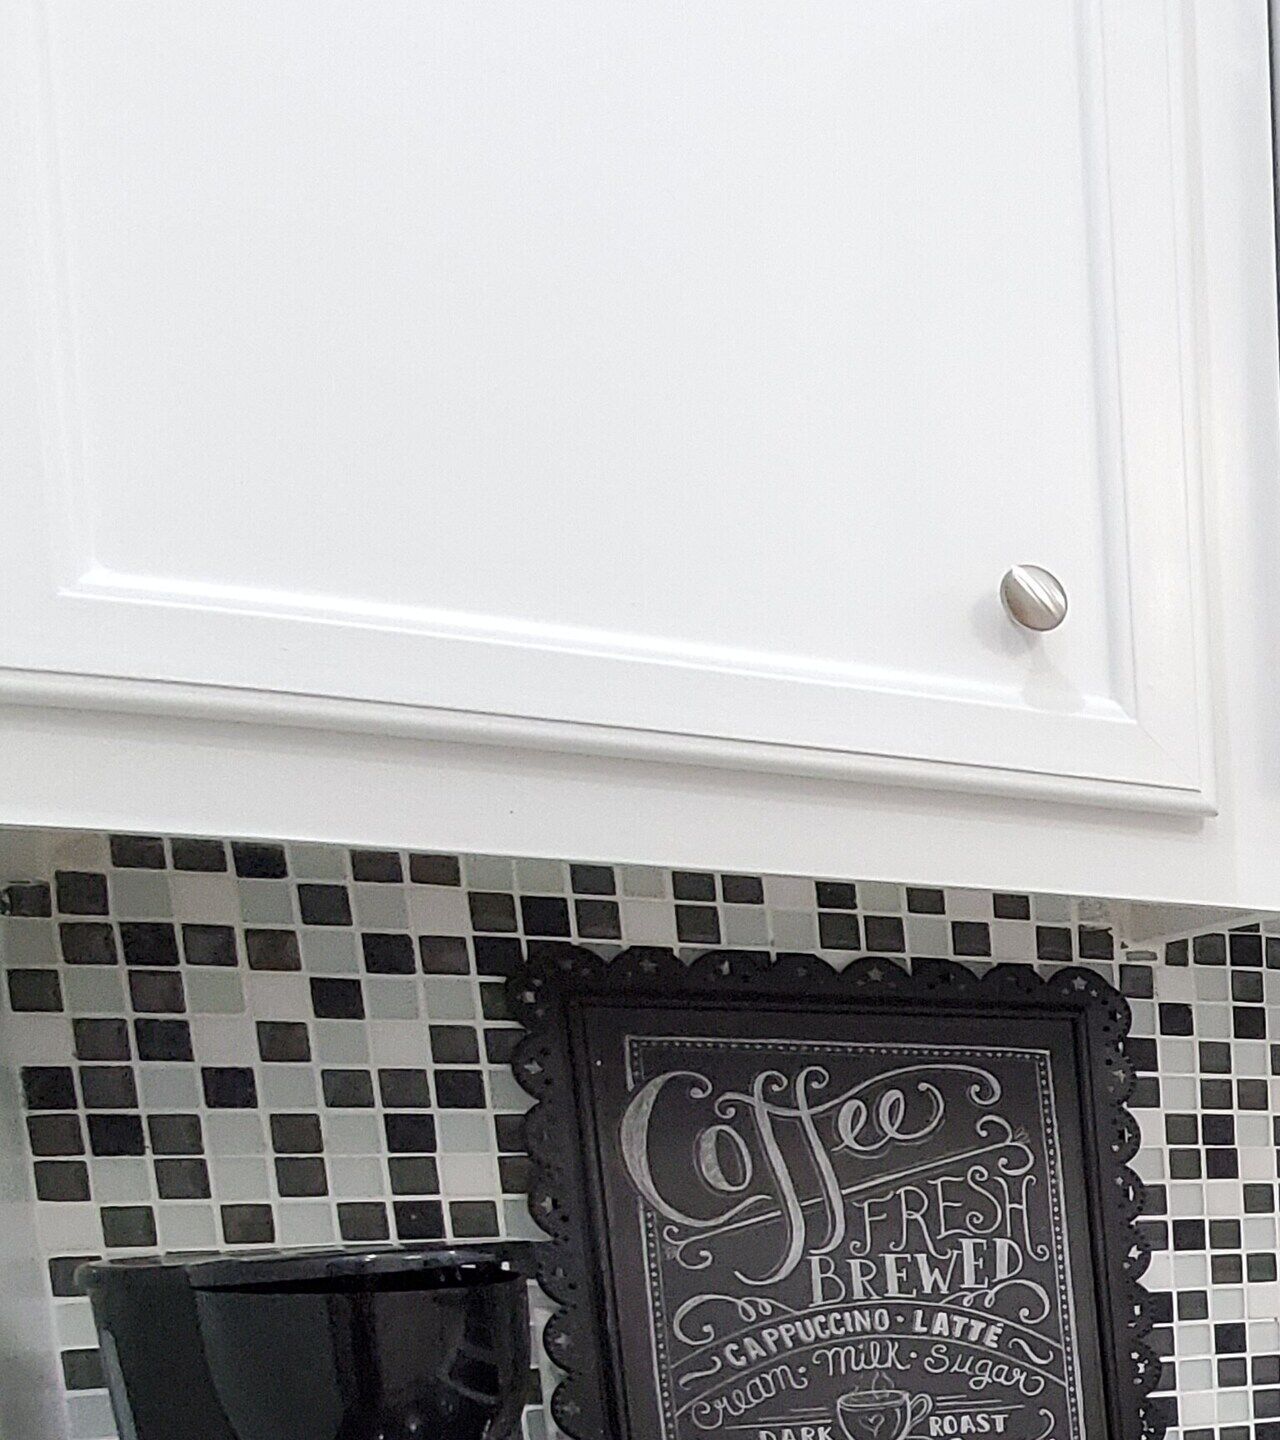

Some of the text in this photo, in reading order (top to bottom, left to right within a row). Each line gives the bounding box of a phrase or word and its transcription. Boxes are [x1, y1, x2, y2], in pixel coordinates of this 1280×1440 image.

[620, 1066, 1000, 1285] Coffee
[849, 1166, 1050, 1261] FRESH
[807, 1237, 1023, 1304] BREWED
[723, 1308, 890, 1366] CAPPUCCINO
[924, 1344, 1045, 1396] Sugar
[929, 1412, 1009, 1437] ROAST
